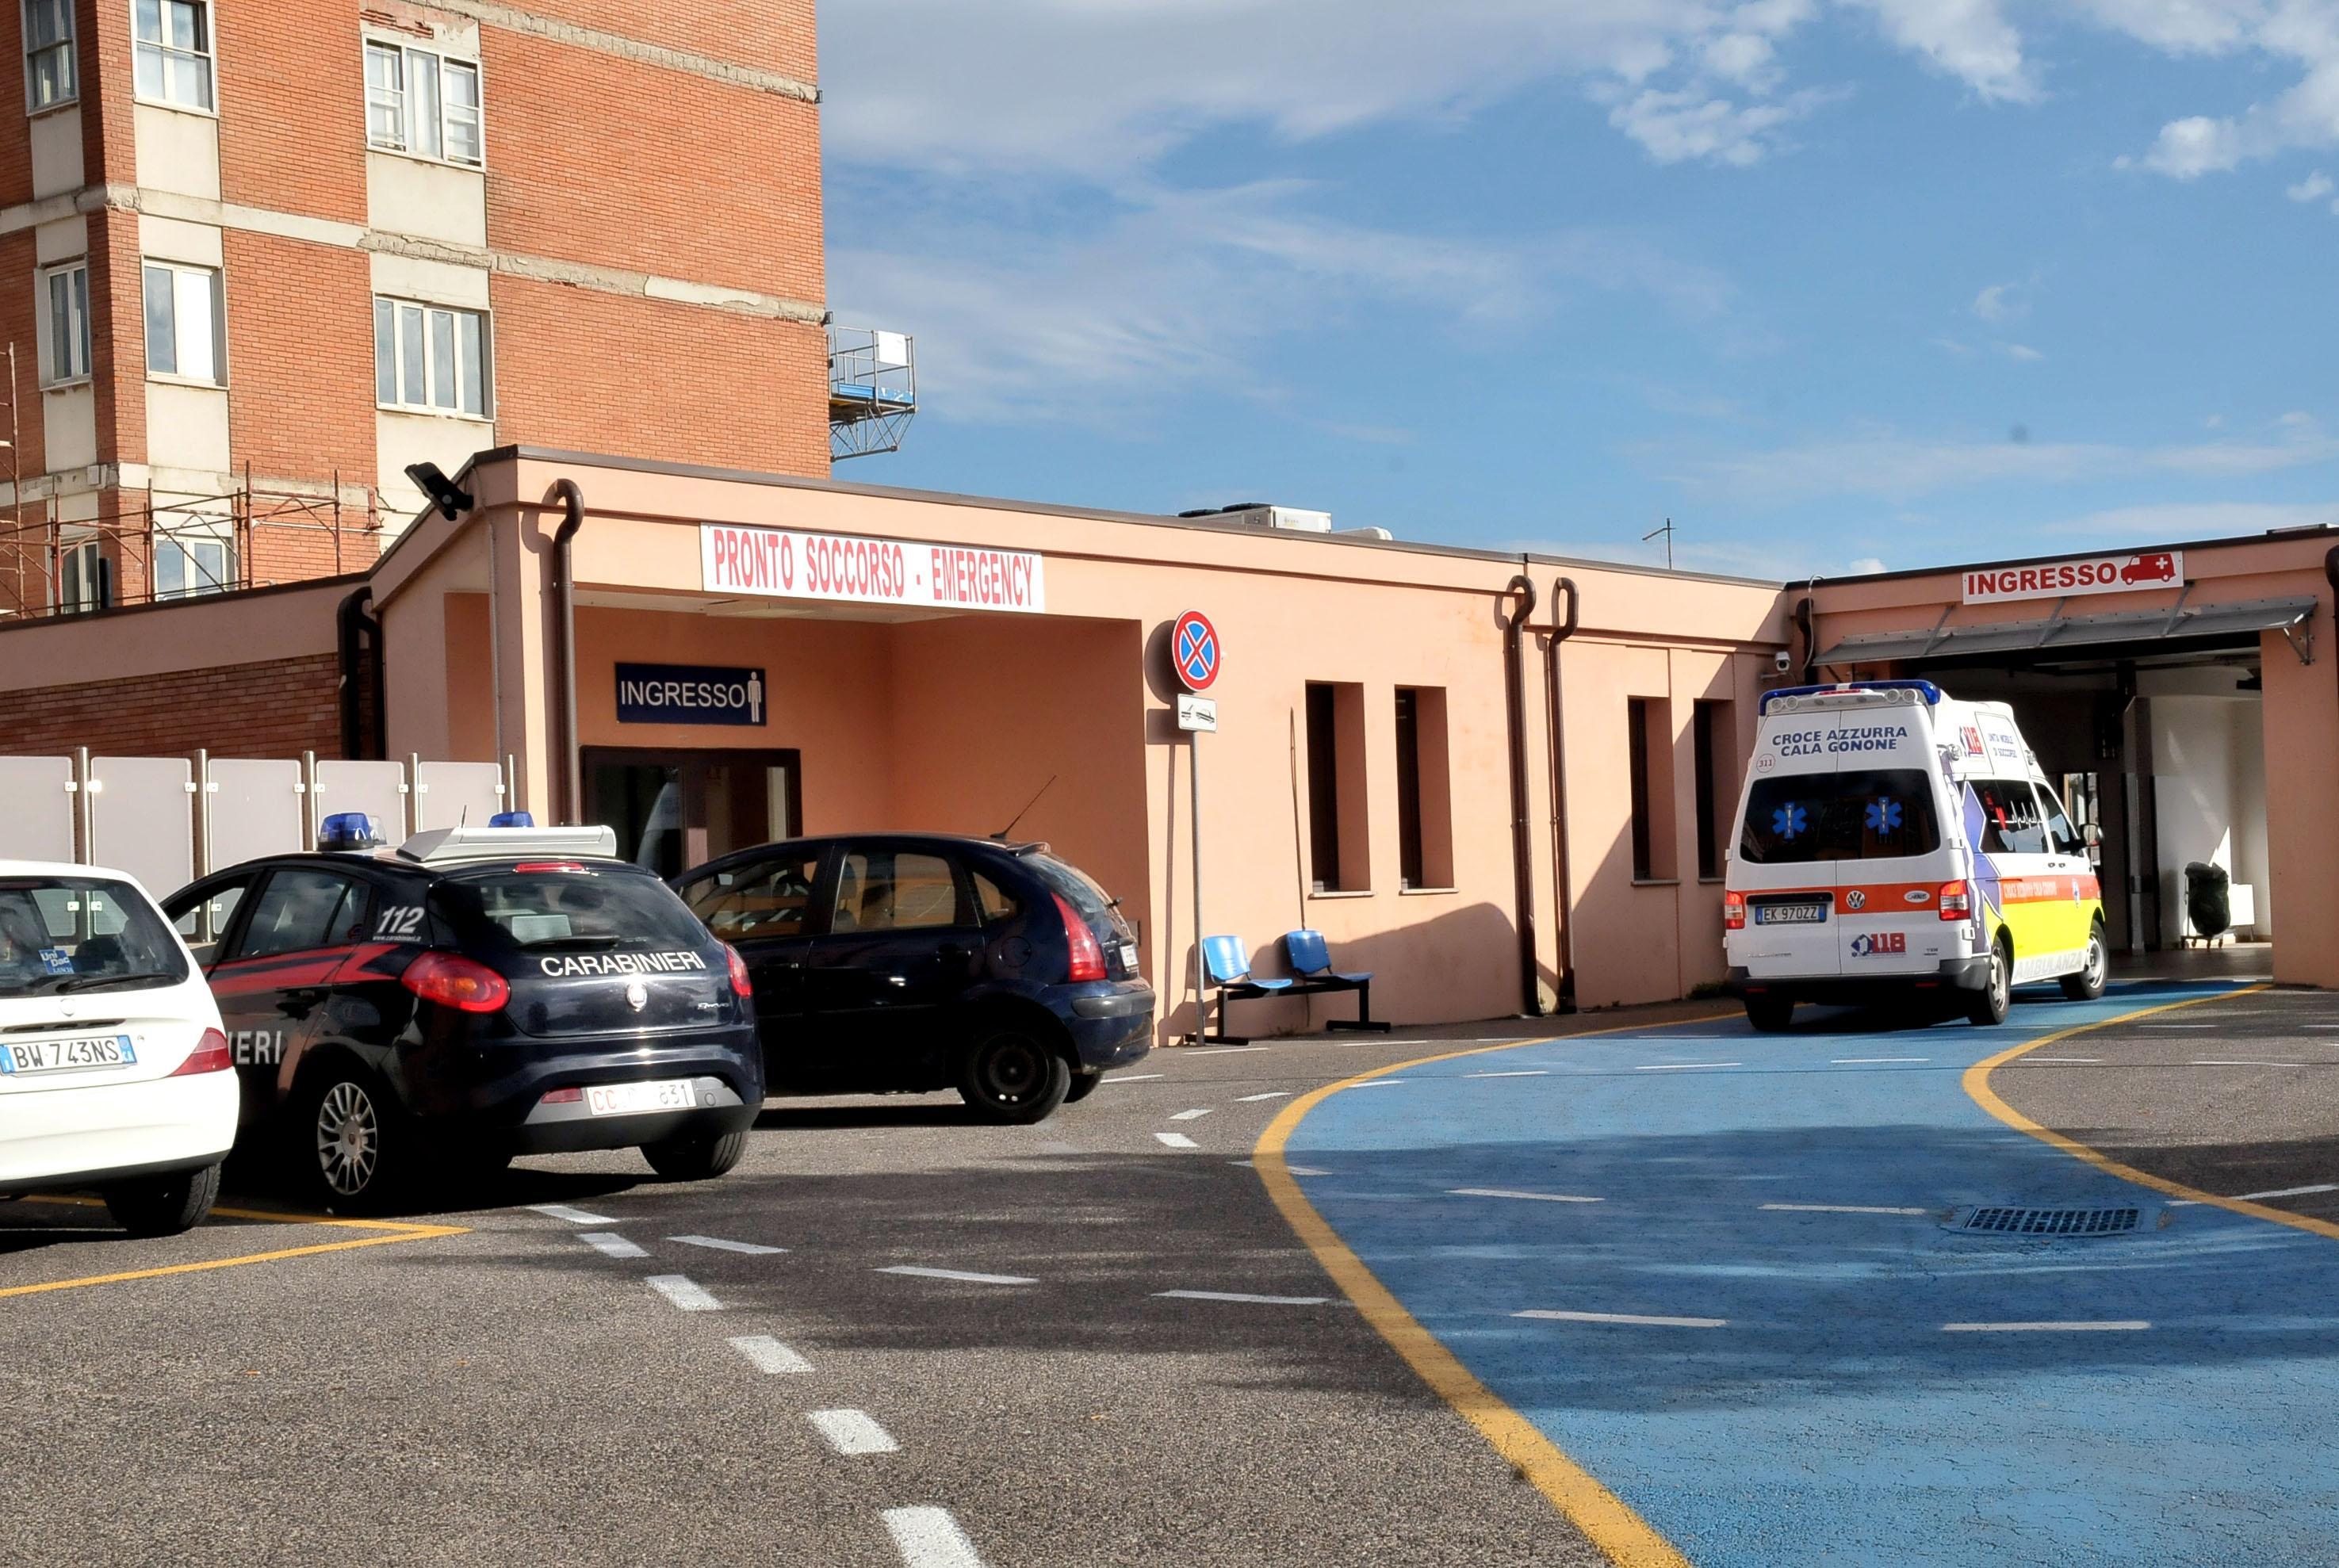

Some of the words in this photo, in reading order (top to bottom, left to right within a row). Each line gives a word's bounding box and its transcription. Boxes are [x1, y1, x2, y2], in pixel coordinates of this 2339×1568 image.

[714, 530, 794, 591] PRONTO
[806, 537, 905, 598] SOCCORSO
[931, 548, 1032, 606] EMERGENCY
[1967, 562, 2117, 595] INGRESSO
[620, 680, 746, 709] INGRESSO
[1771, 730, 1822, 746] CROCE
[1826, 726, 1908, 741] AZZURRA
[1781, 743, 1823, 757] CALA
[1828, 739, 1897, 753] GONONE
[377, 905, 425, 933] 112
[1763, 908, 1778, 920] EK
[1782, 906, 1817, 920] 970ZZ
[1870, 932, 1906, 952] 118
[40, 950, 58, 961] Uni
[50, 957, 70, 967] Dac
[541, 950, 707, 977] CARABINIERI
[2015, 951, 2082, 978] AMBULANZA
[13, 1045, 44, 1068] BW
[49, 1039, 119, 1065] 743NS
[593, 1089, 617, 1111] CC
